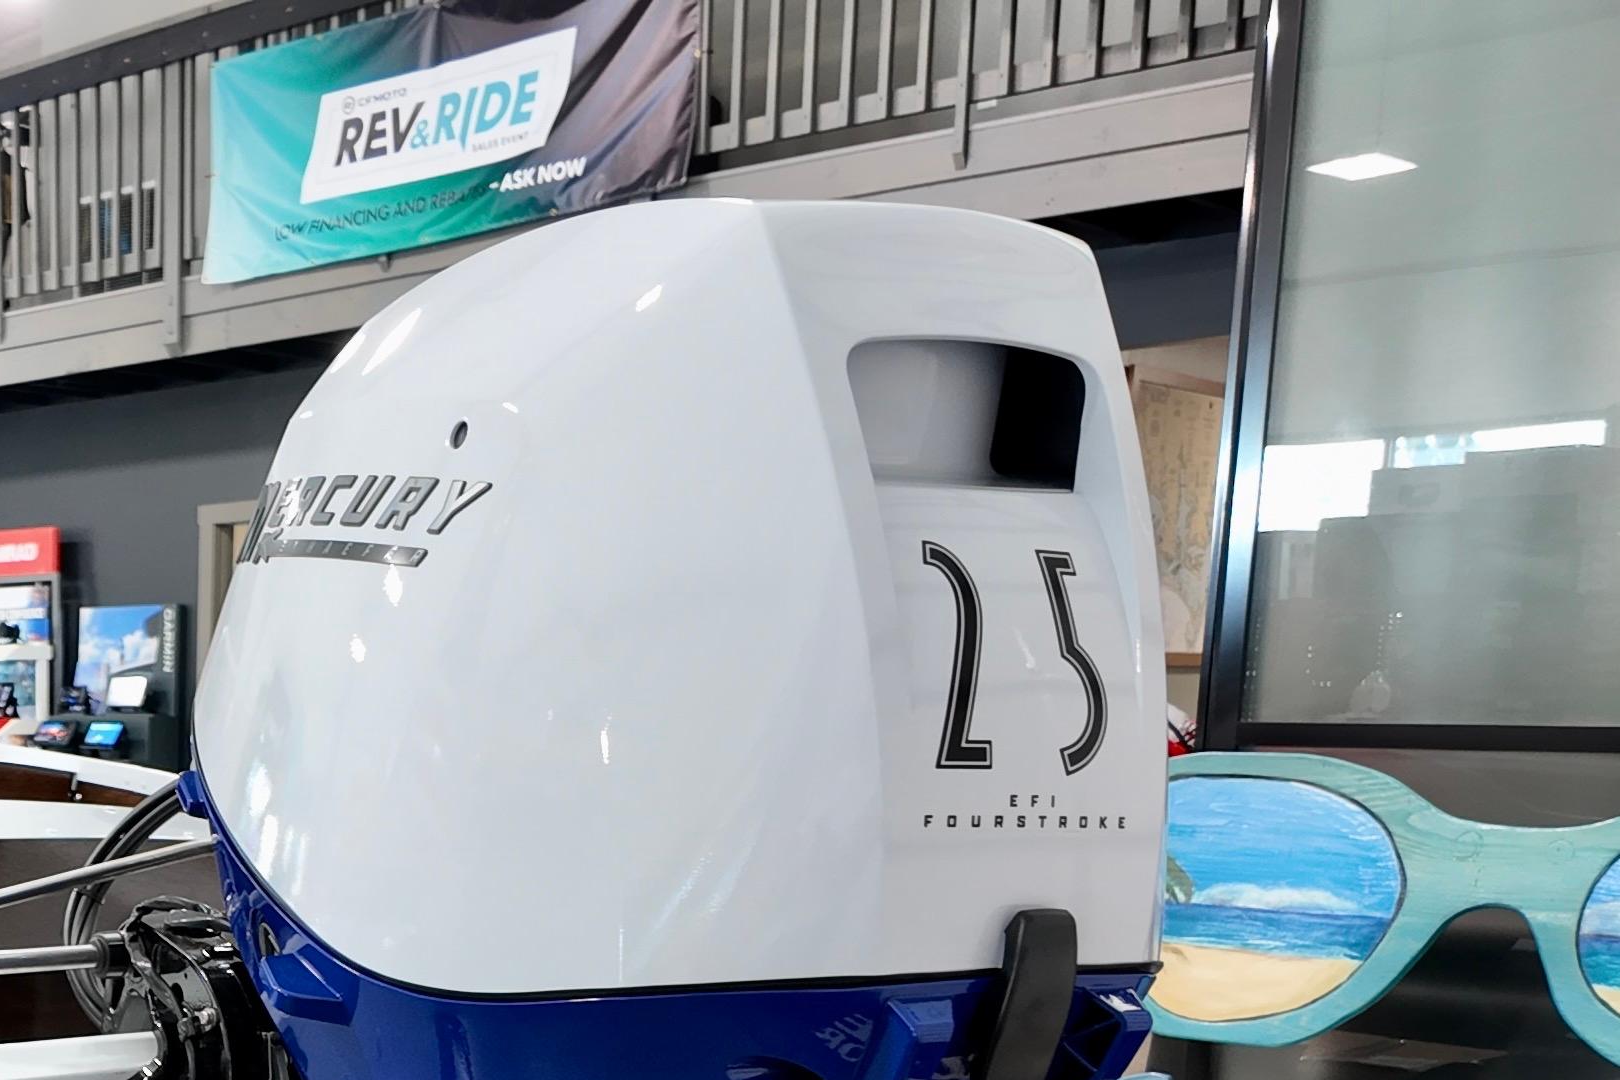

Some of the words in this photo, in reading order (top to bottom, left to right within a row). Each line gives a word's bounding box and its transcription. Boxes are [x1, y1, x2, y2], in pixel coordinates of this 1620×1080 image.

[307, 204, 391, 235] FINANCING
[393, 196, 427, 217] AND
[537, 156, 587, 186] NOW
[922, 540, 1108, 776] 25
[923, 814, 1127, 830] FOURSTROKE
[1010, 794, 1056, 808] EFI
